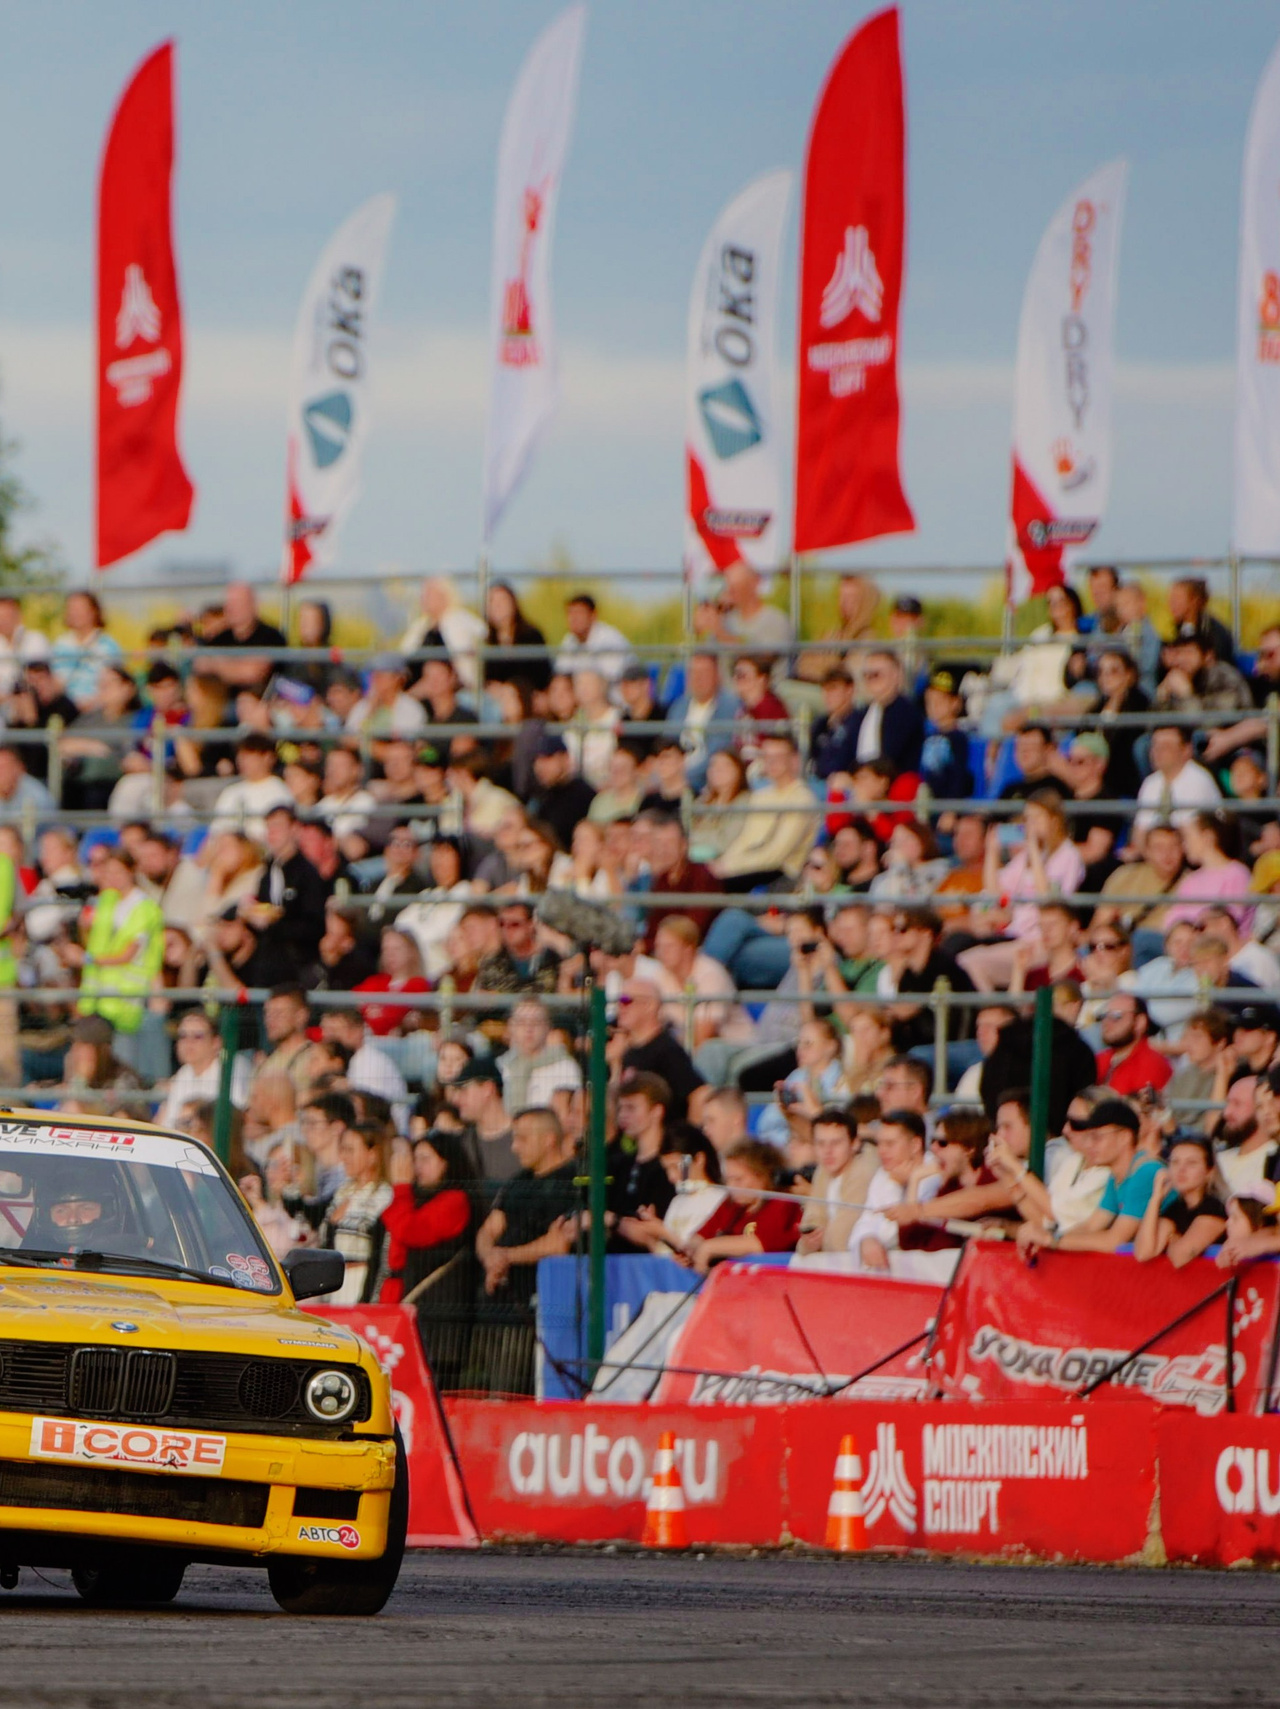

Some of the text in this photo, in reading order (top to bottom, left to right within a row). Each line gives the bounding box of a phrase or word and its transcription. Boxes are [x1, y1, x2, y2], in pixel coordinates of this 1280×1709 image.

[49, 1127, 134, 1145] FEST
[280, 1339, 337, 1348] GYMKHANA
[83, 1428, 224, 1464] CORE
[923, 1414, 1088, 1480] МОСКОВСКИЙ
[923, 1480, 1002, 1533] СПОРТ
